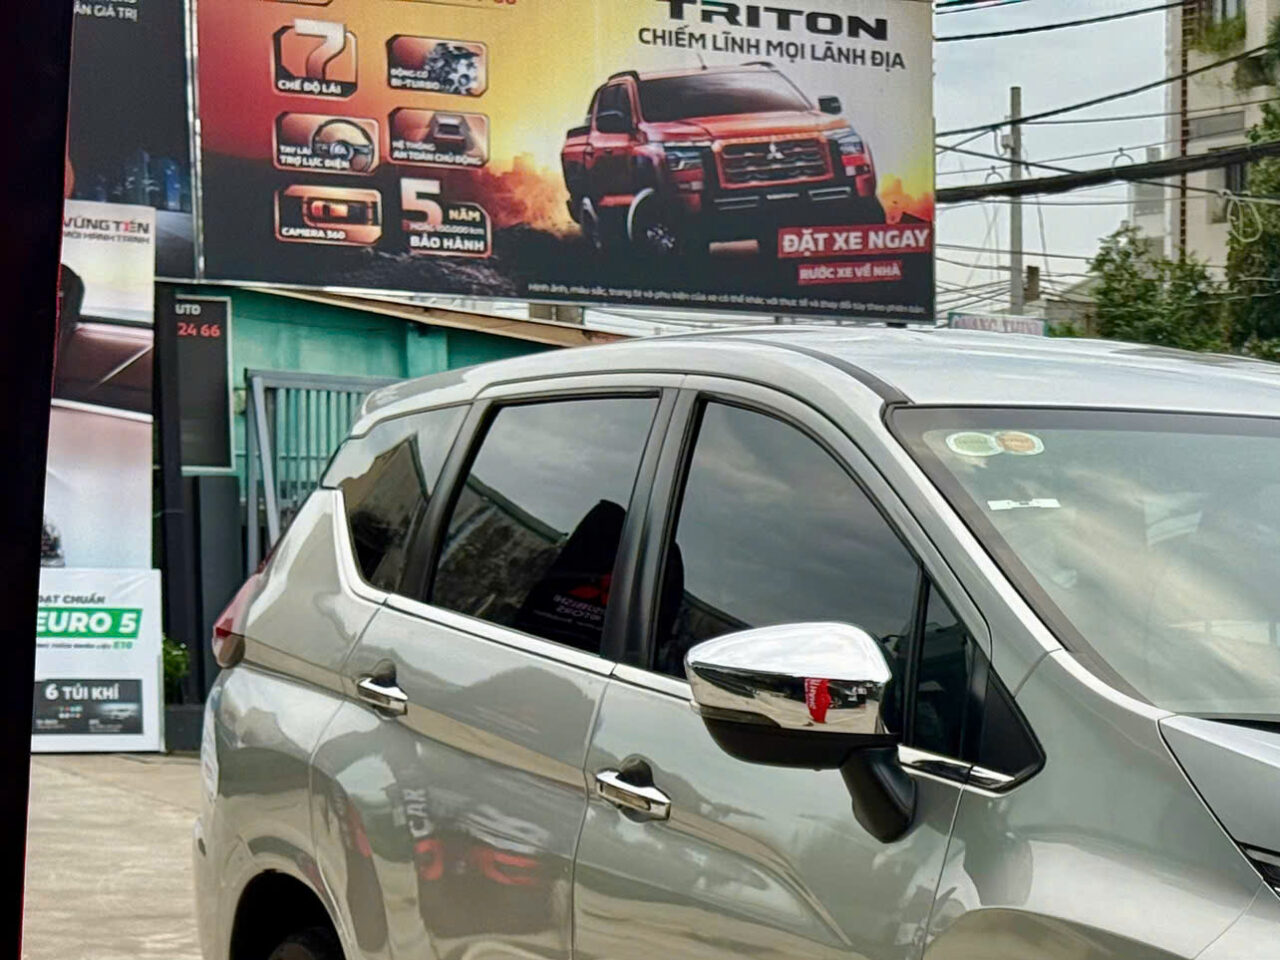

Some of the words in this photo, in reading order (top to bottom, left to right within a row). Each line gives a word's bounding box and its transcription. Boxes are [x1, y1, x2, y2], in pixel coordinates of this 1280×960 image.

[656, 0, 888, 40] TRITON
[294, 18, 346, 79] 7
[638, 25, 706, 49] CHIẾM
[712, 32, 761, 55] LĨNH
[766, 40, 806, 63] MỌI
[811, 41, 866, 66] LÃNH
[870, 50, 905, 72] ĐỊA
[278, 79, 302, 91] CHẾ
[303, 80, 321, 94] ĐỘ
[322, 82, 341, 94] LÁI
[401, 178, 442, 224] 5
[449, 208, 481, 222] NĂM
[282, 227, 325, 238] CAMERA
[326, 229, 346, 239] 360
[410, 232, 440, 247] BẢO
[443, 236, 485, 251] HÀNH
[783, 228, 829, 257] ĐẶT
[832, 231, 863, 250] XE
[868, 228, 929, 249] NGAY
[837, 267, 853, 278] XE
[873, 263, 901, 276] NHÀ
[177, 322, 196, 336] 24
[200, 324, 221, 337] 66
[37, 611, 112, 633] EURO
[119, 612, 138, 633] 5
[45, 683, 59, 700] 6
[62, 683, 88, 700] TÚI
[92, 683, 120, 700] KHÍ
